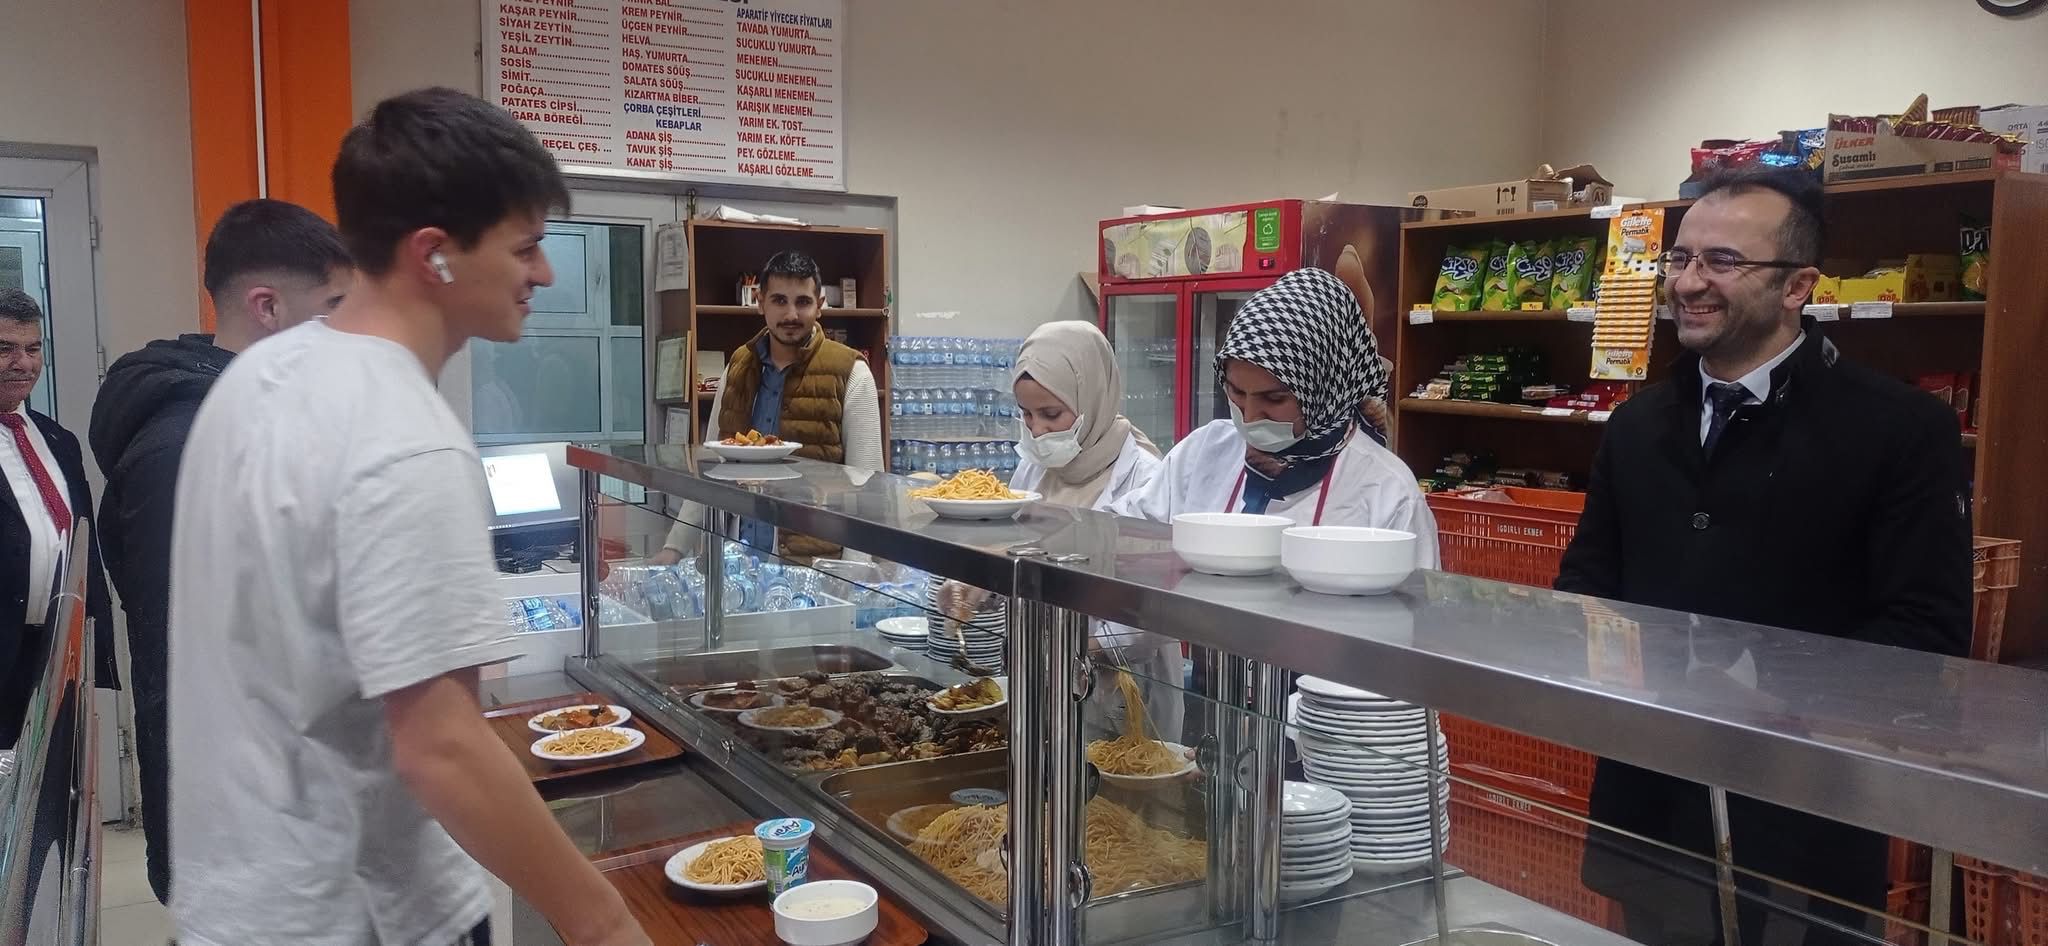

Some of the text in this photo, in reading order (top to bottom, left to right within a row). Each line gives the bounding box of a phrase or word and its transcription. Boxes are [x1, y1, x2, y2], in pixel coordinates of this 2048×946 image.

[500, 4, 536, 17] KAŞAR
[621, 6, 648, 17] KREM
[499, 16, 531, 29] SİYAH
[736, 7, 832, 28] APARATİF YİYECEK FİYATLARI
[621, 19, 653, 32] ÜÇGEN
[736, 22, 769, 35] TAVADA
[501, 30, 532, 43] YEŞİL
[736, 37, 776, 51] SUCUKLU
[622, 48, 643, 60] HAŞ.
[622, 62, 665, 75] DOMATES
[623, 76, 658, 87] SALATA
[735, 69, 775, 82] SUCUKLU
[624, 89, 671, 102] KIZARTMA
[736, 85, 773, 98] KAŞARLI
[501, 97, 547, 109] PATATES
[624, 103, 654, 115] ÇORBA
[736, 100, 770, 114] KARIŞIK
[655, 119, 702, 131] KEBAPLAR
[738, 117, 764, 129] YARIM
[766, 119, 779, 129] EK.
[626, 130, 656, 141] ADANA
[737, 132, 762, 143] YARIM
[764, 134, 778, 145] EK.
[626, 144, 657, 155] TAVUK
[1834, 137, 1875, 150] ÜLKER
[737, 147, 755, 159] PEY.
[626, 158, 656, 168] KANAT
[738, 163, 773, 176] KAŞARLI
[1621, 215, 1652, 227] Gillette
